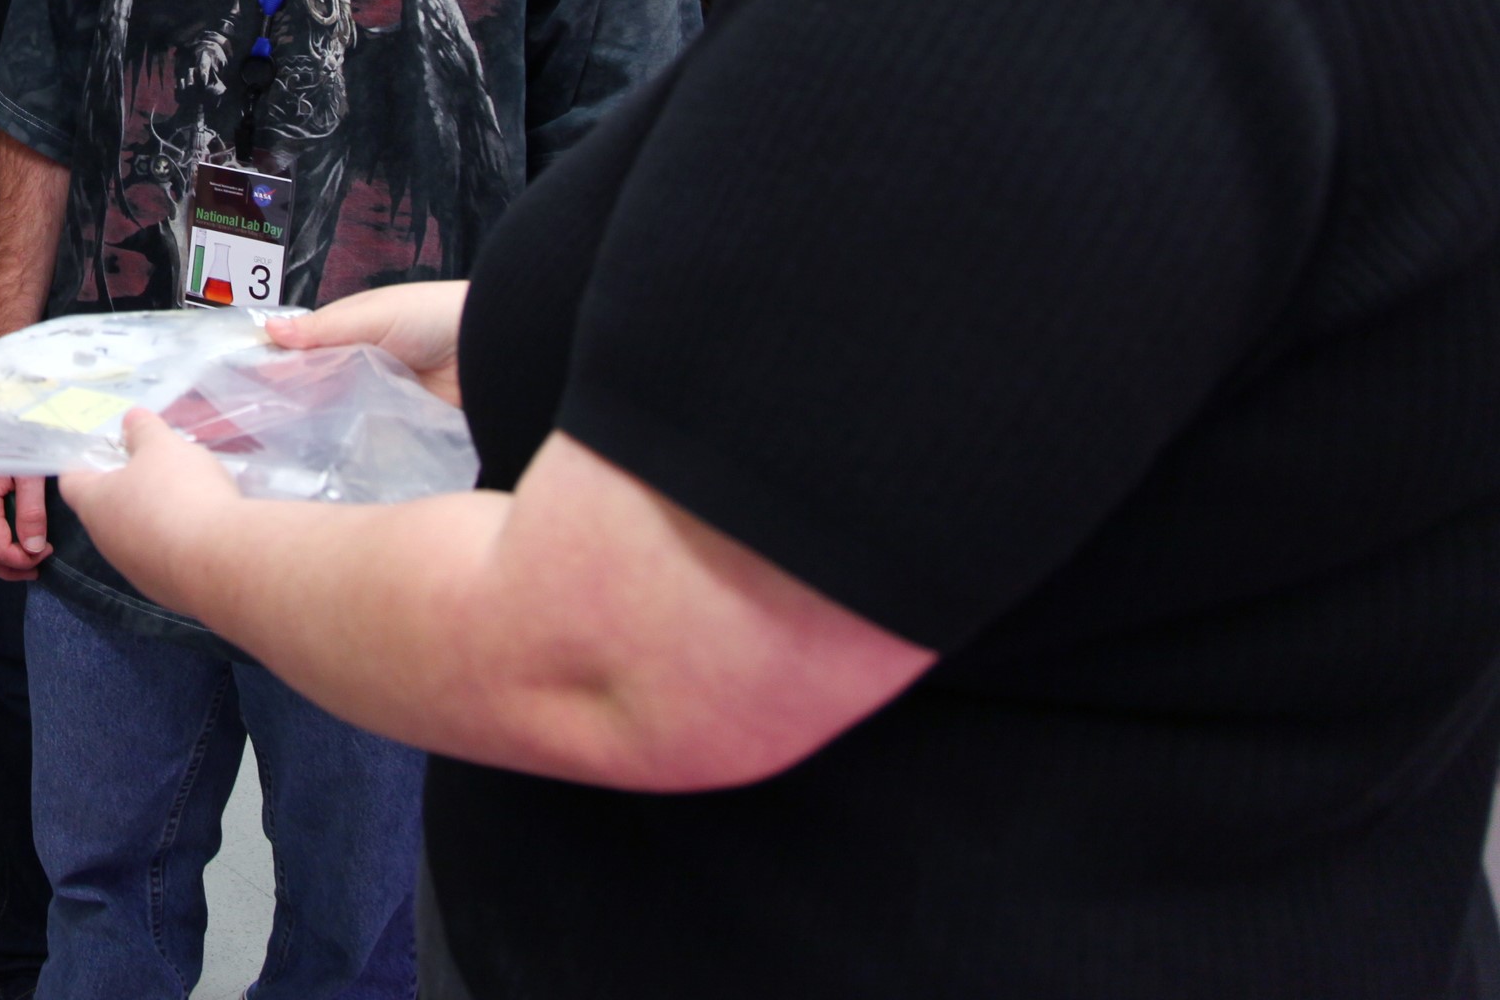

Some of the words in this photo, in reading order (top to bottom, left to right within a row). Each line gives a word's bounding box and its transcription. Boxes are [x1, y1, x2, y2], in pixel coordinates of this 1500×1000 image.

[253, 191, 272, 200] NASA
[195, 207, 239, 227] National
[241, 217, 260, 232] Lab
[263, 222, 283, 239] Day
[253, 255, 272, 265] GROUP
[248, 264, 271, 301] 3
